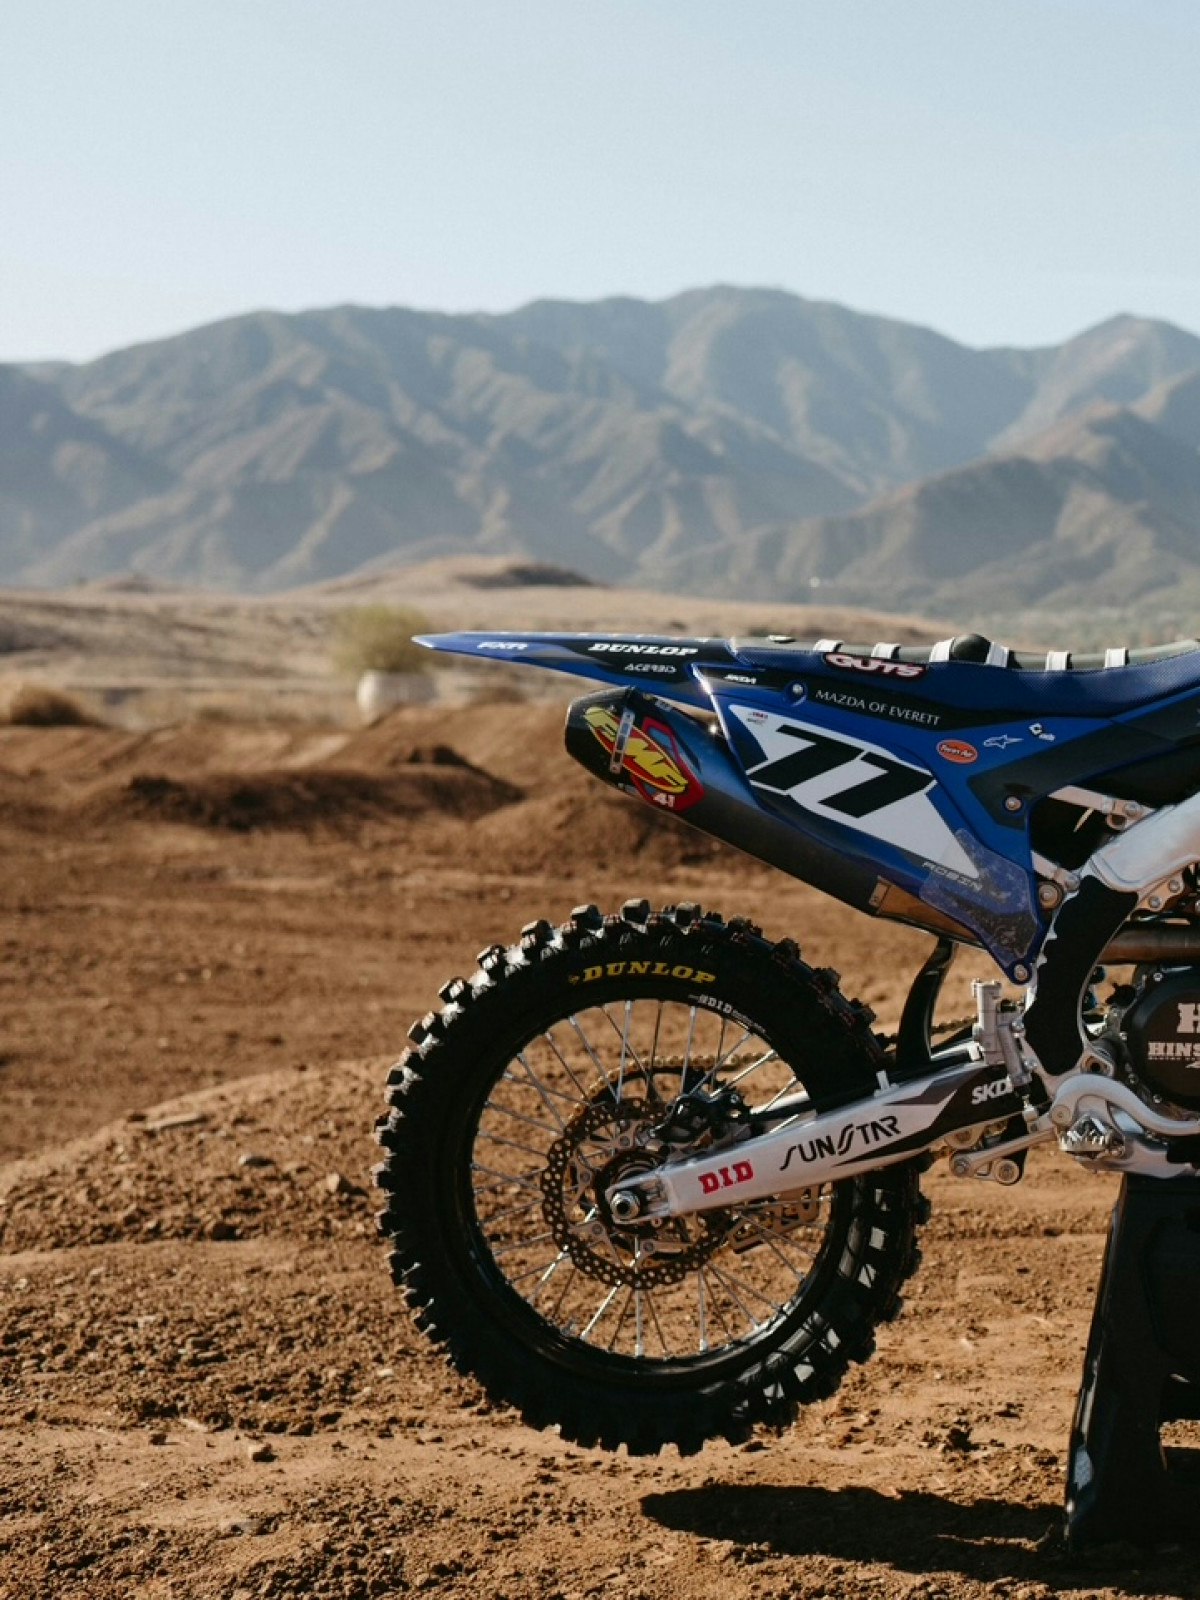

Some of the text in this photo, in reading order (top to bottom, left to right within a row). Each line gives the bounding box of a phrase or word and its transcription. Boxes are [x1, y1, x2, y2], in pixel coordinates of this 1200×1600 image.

[587, 642, 699, 657] DUNLOP
[826, 653, 924, 679] GUTS
[815, 688, 942, 727] MAZDA OF EVERETT
[746, 723, 936, 819] 77
[582, 961, 717, 985] DUNLOP
[970, 1076, 1014, 1106] SKD
